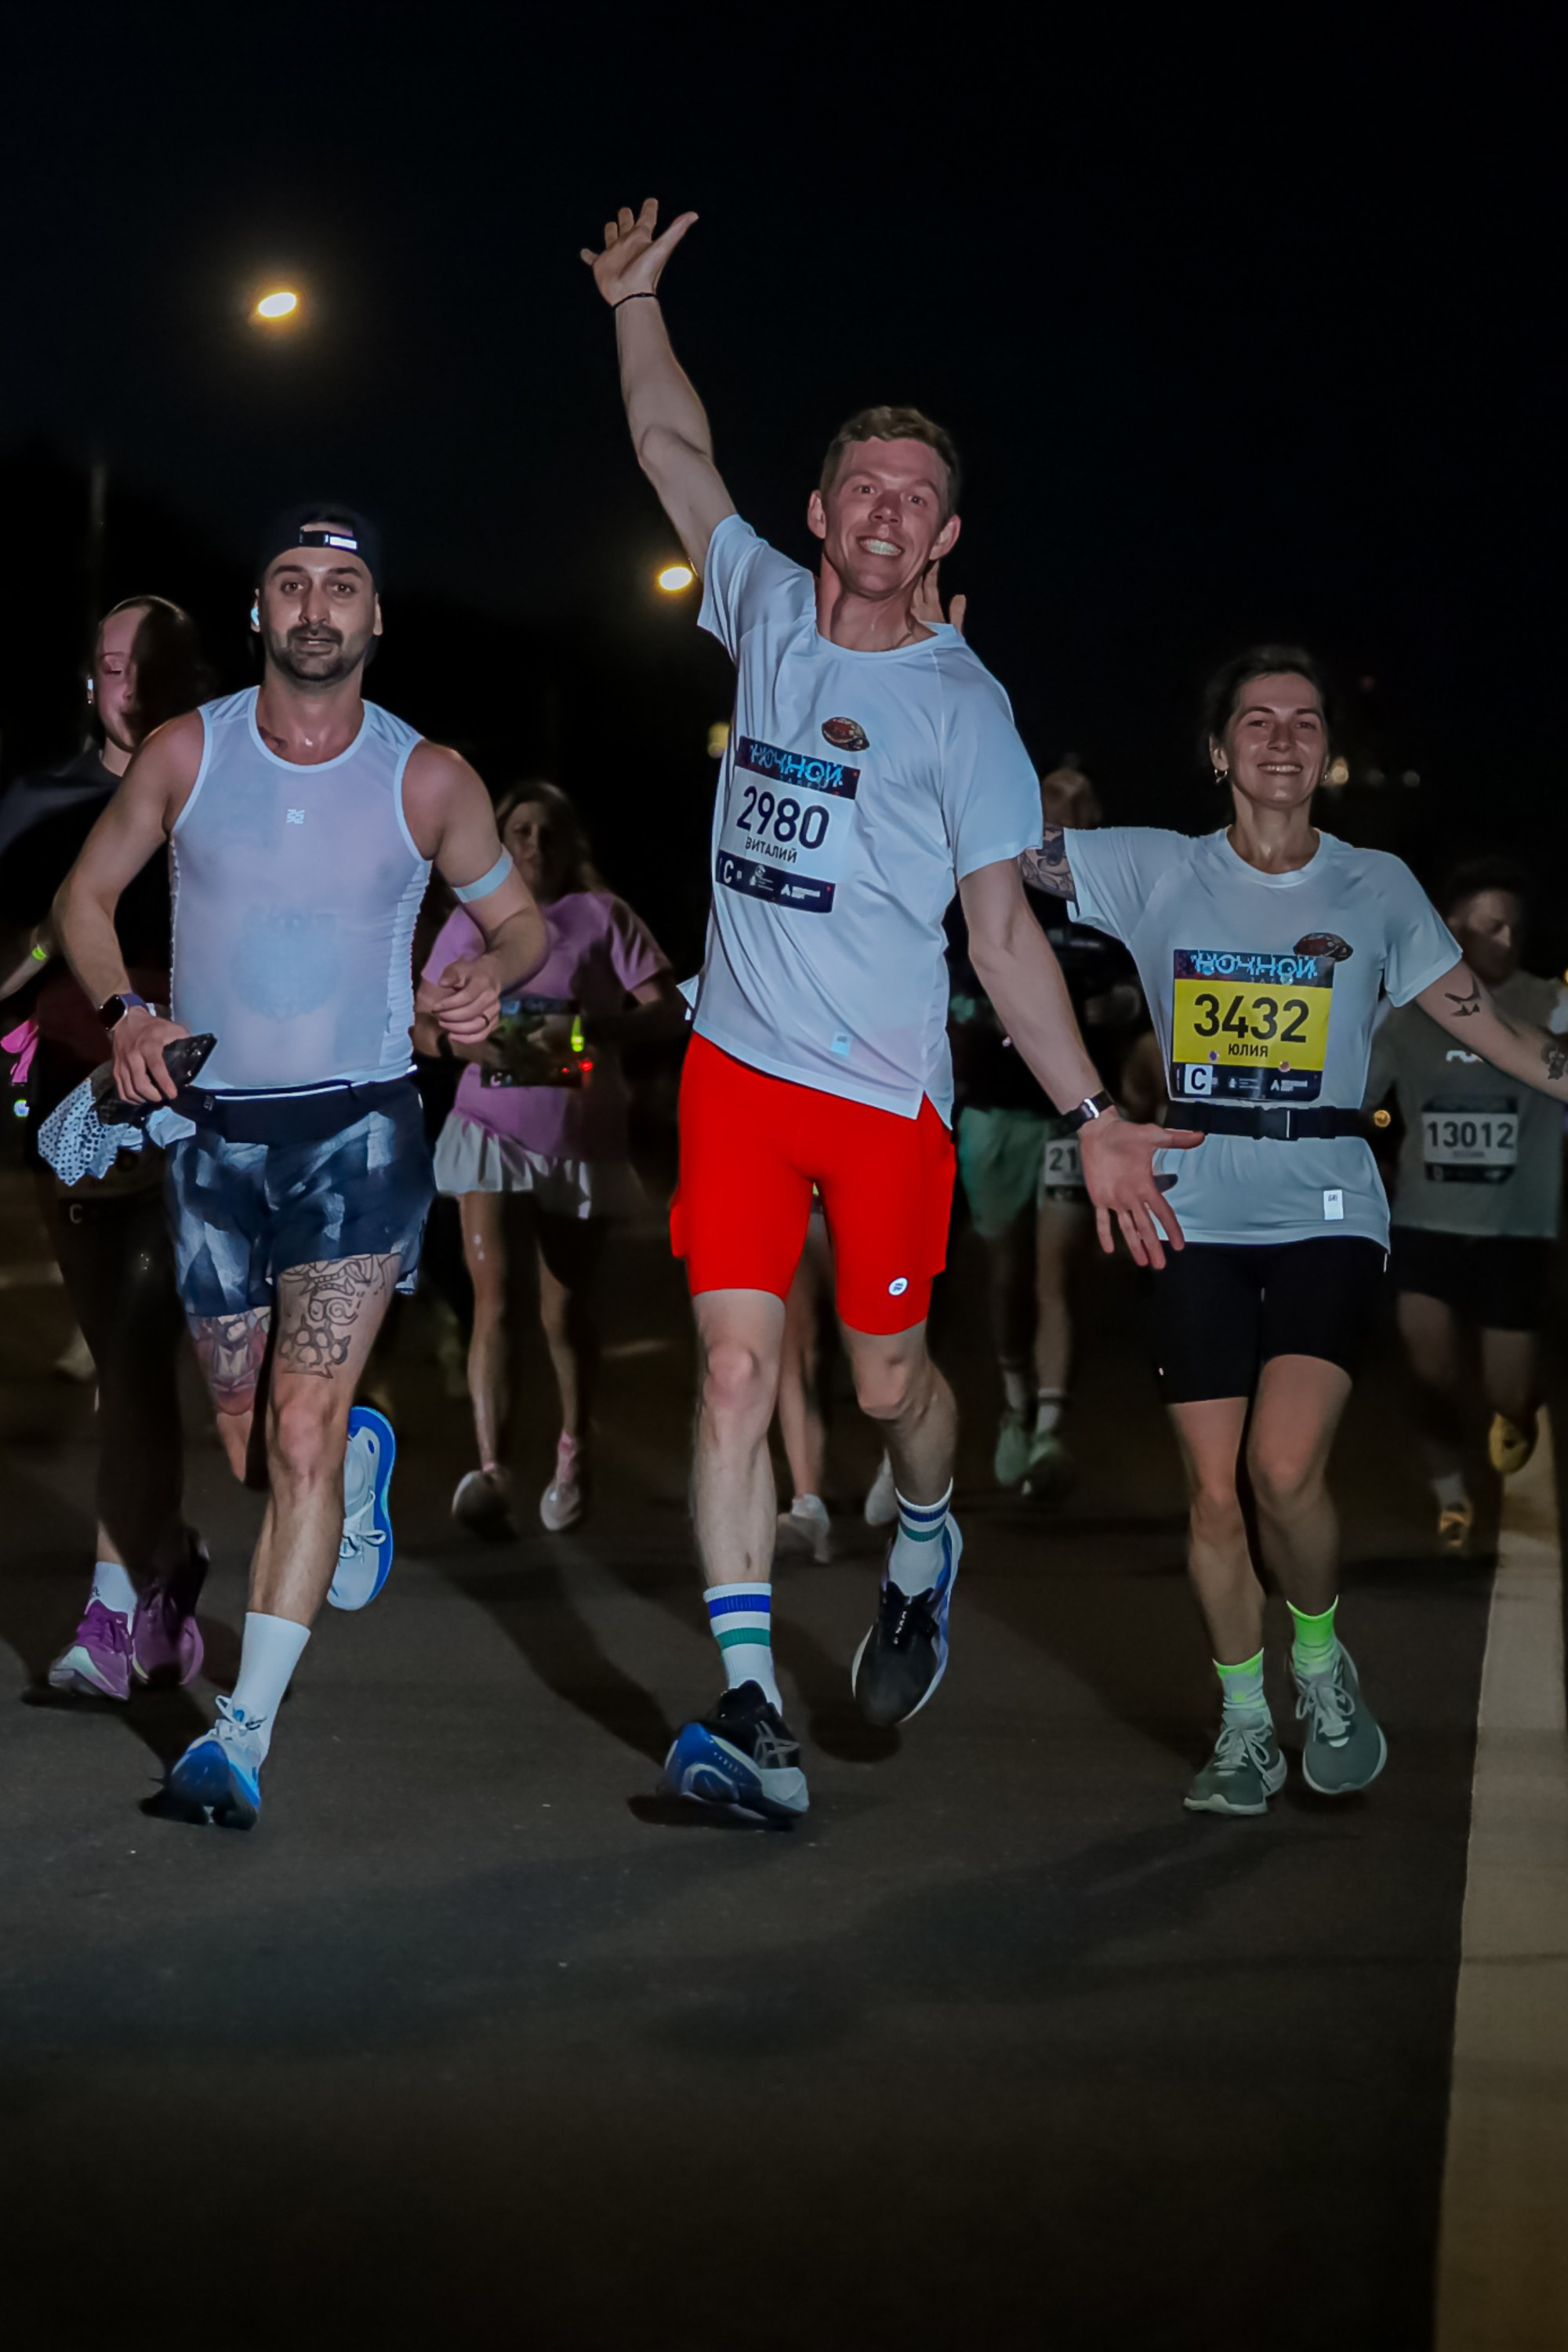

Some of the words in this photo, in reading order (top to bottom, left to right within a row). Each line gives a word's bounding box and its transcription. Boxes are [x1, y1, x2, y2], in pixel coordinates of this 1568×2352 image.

[736, 786, 829, 850] 2980
[746, 836, 798, 863] ВИТАЛИЙ
[1193, 993, 1309, 1043] 3432
[1229, 1044, 1269, 1058] ЮЛИЯ
[1427, 1121, 1514, 1149] 13012
[1049, 1147, 1076, 1171] 21
